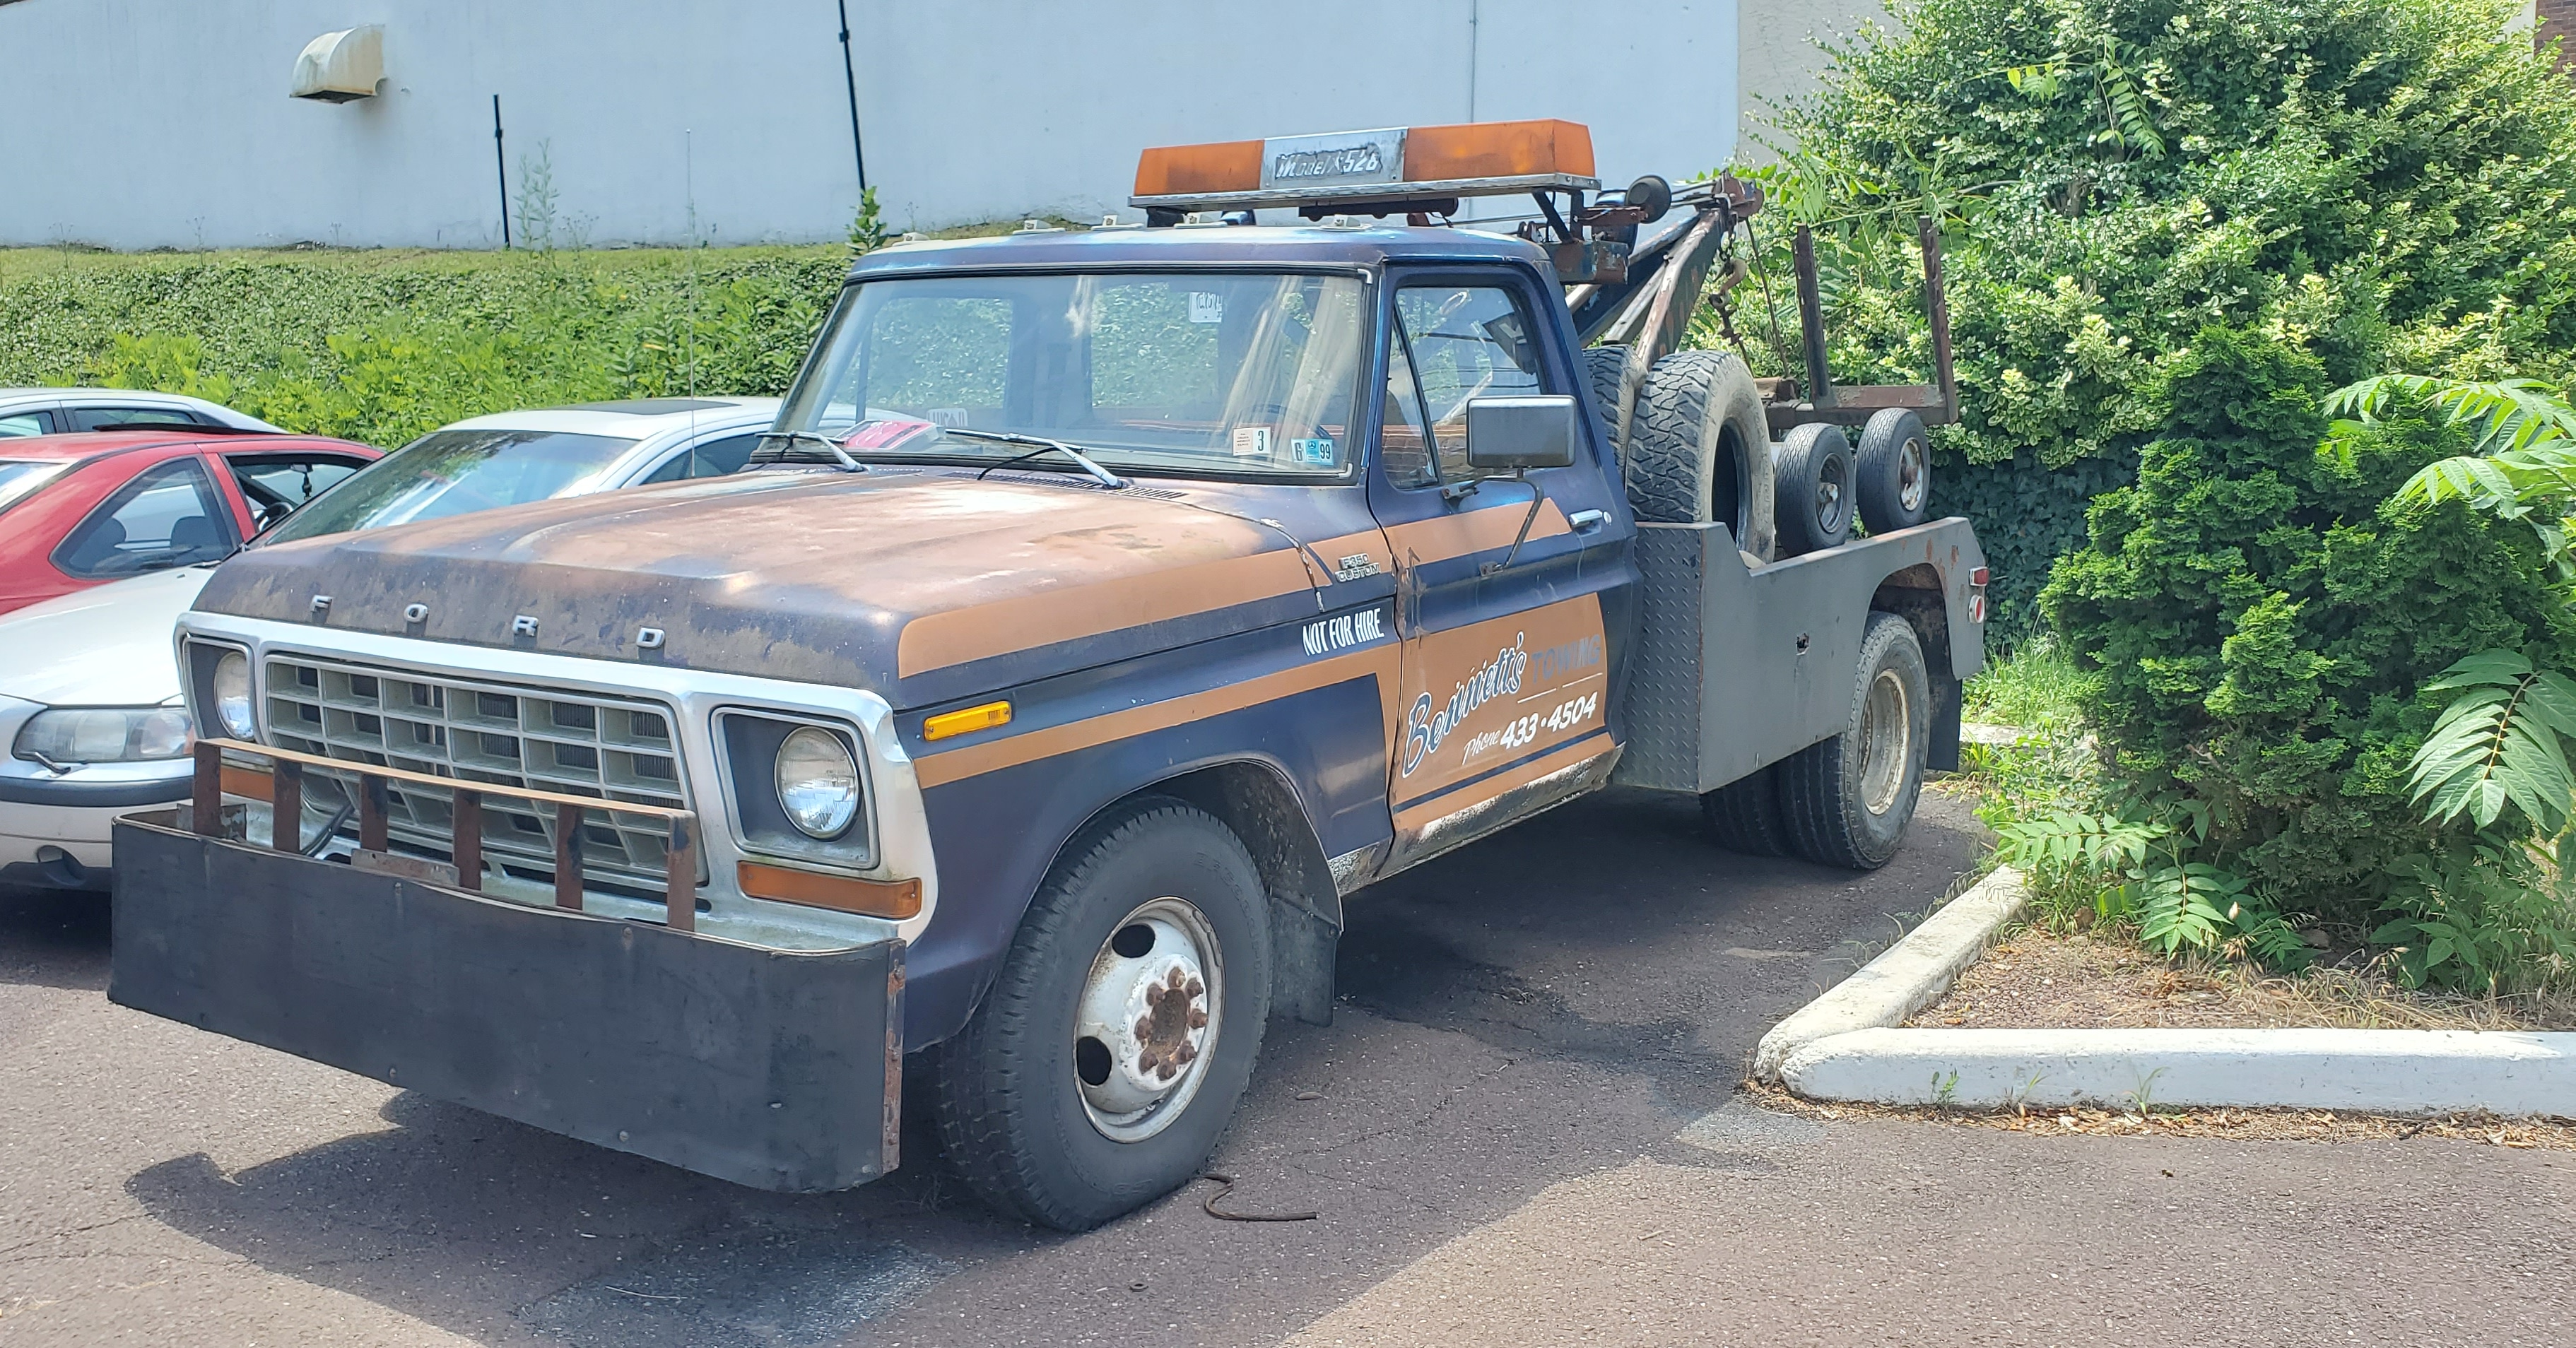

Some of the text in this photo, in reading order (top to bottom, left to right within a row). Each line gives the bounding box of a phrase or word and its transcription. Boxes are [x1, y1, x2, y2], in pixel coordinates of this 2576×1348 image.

[1257, 430, 1264, 451] 3
[1295, 442, 1303, 461] 6
[1320, 443, 1331, 460] 99
[1337, 562, 1381, 582] CUSTOM
[1342, 553, 1370, 569] F350
[310, 594, 666, 649] FORD
[1302, 608, 1384, 656] NOT FOR HIRE
[1402, 631, 1601, 779] Bennett's TOWING
[1462, 730, 1500, 765] Phone
